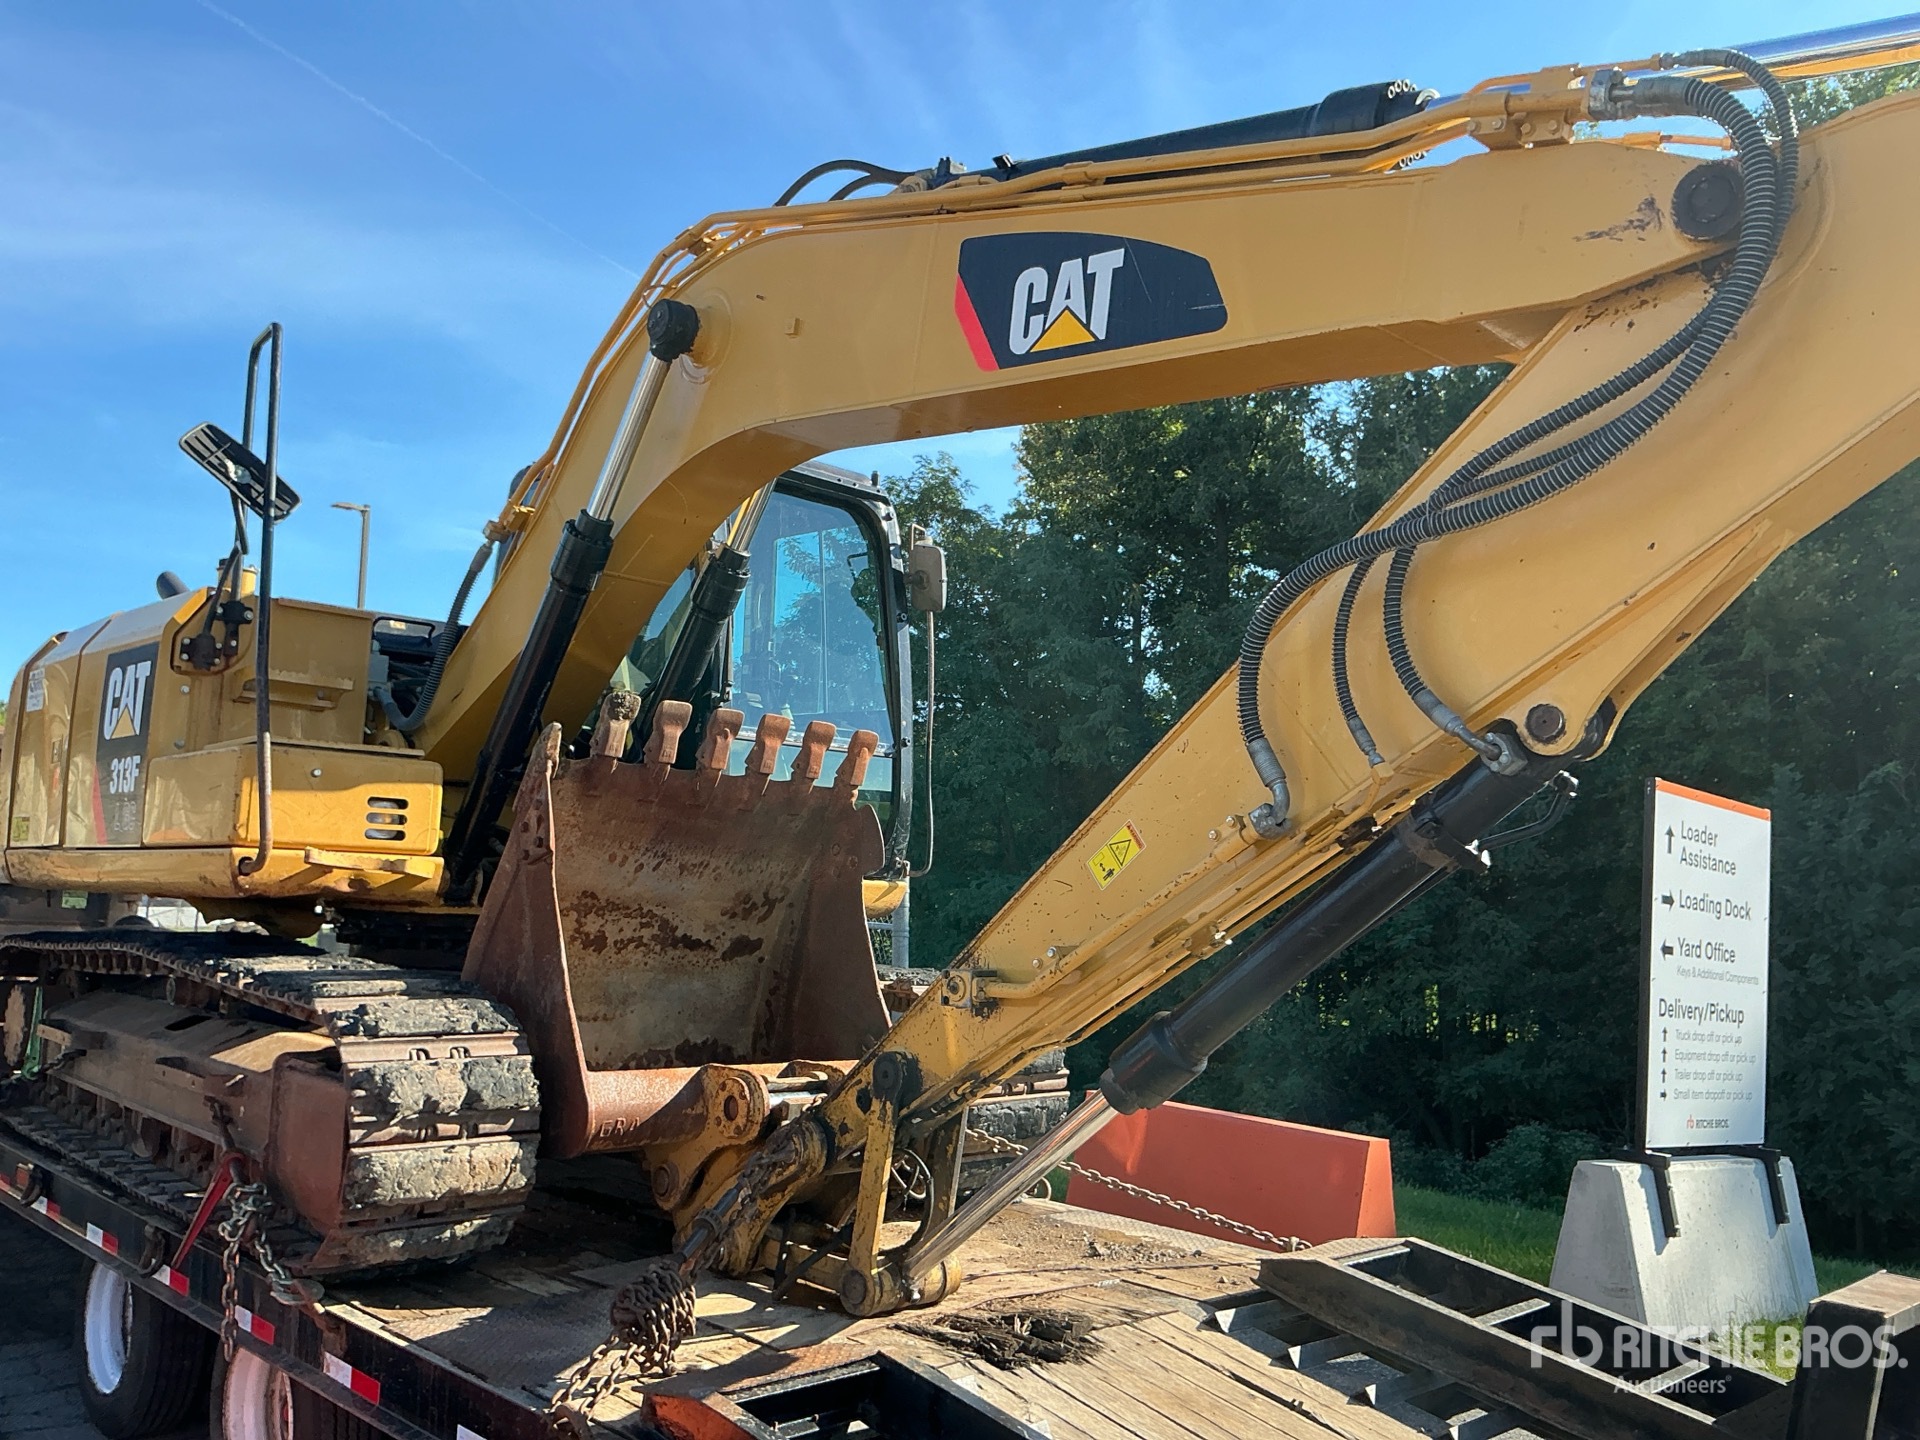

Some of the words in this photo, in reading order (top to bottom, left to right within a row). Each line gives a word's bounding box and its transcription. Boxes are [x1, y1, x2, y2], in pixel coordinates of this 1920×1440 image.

[1009, 248, 1125, 355] CAT
[104, 660, 151, 740] CAT
[109, 755, 141, 794] 313F
[1681, 820, 1718, 847] Loader
[1680, 846, 1736, 876] Assistance
[1679, 889, 1721, 920] Loading
[1725, 899, 1751, 921] Dock
[1677, 937, 1702, 959] Yard
[1705, 942, 1736, 963] Office
[1659, 998, 1745, 1028] Delivery/Pickup
